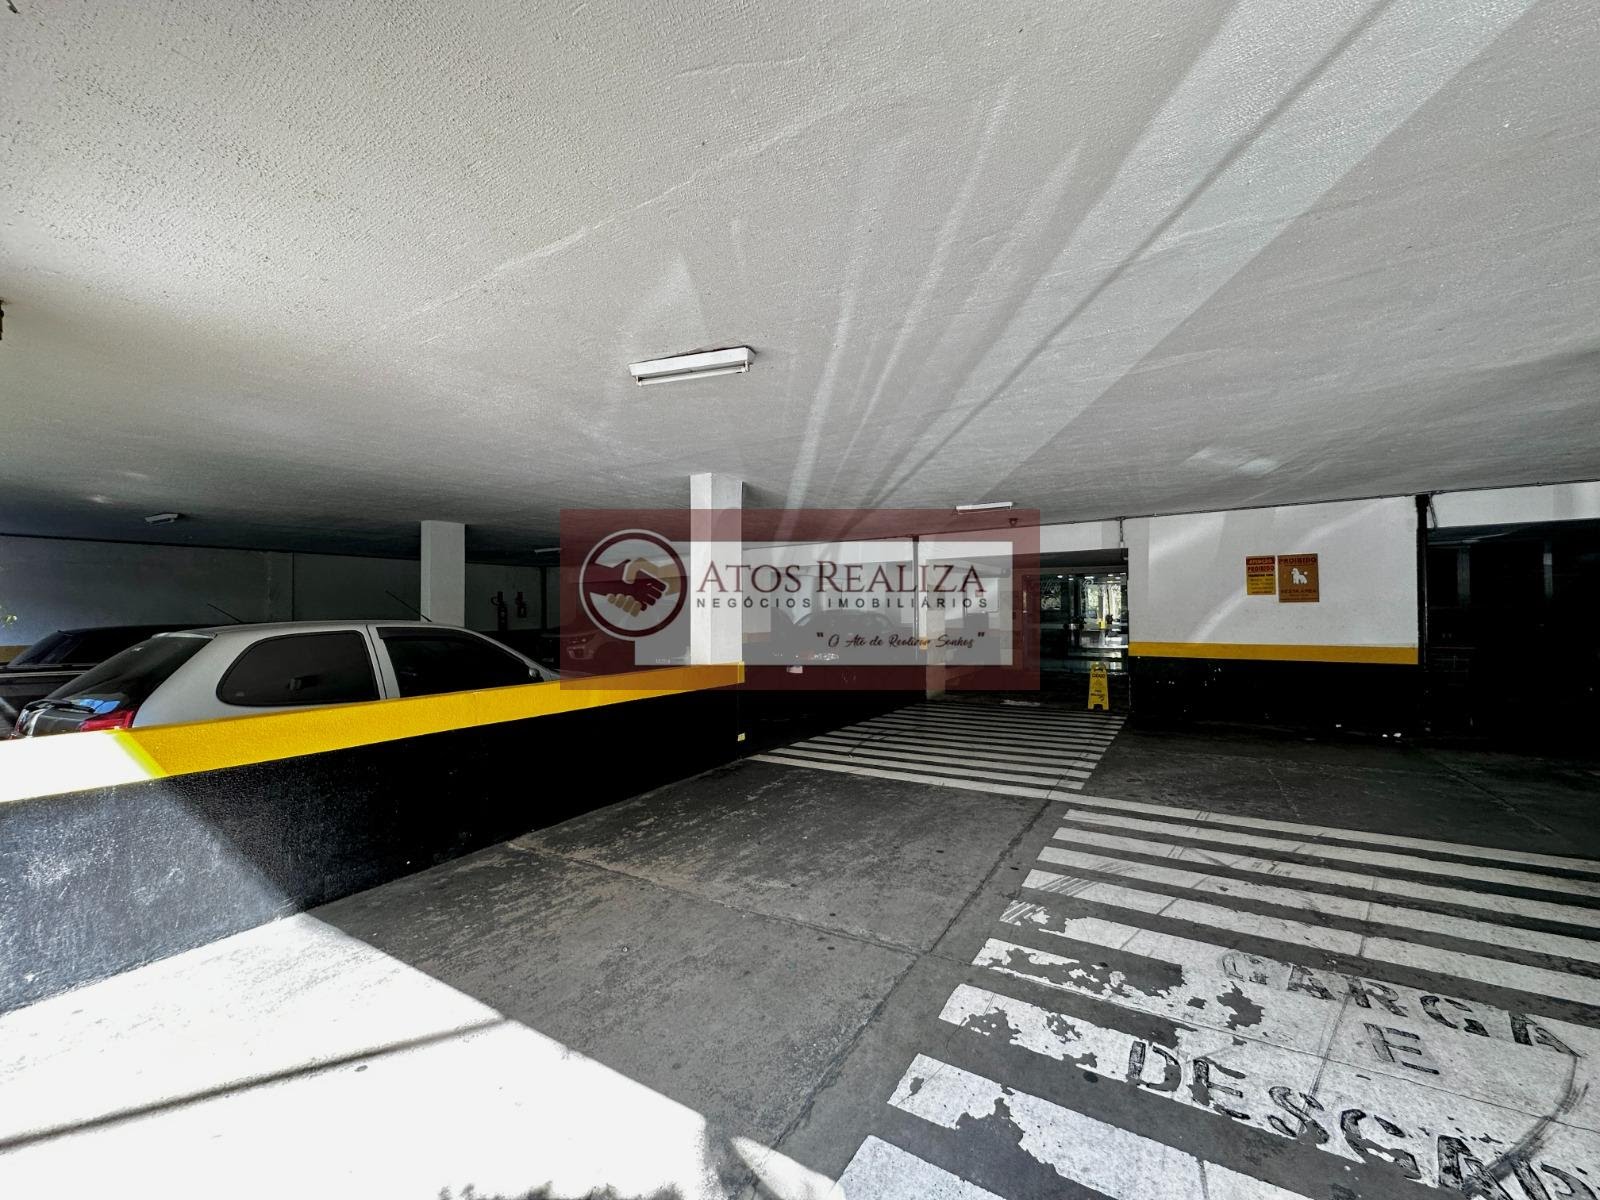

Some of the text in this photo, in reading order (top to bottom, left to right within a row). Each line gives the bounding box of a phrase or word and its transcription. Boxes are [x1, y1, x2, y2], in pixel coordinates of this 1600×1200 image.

[1247, 565, 1275, 573] PROIBIDO
[1279, 557, 1317, 565] PROIBIDO
[1219, 951, 1583, 1059] CARGA
[1363, 1022, 1440, 1075] E
